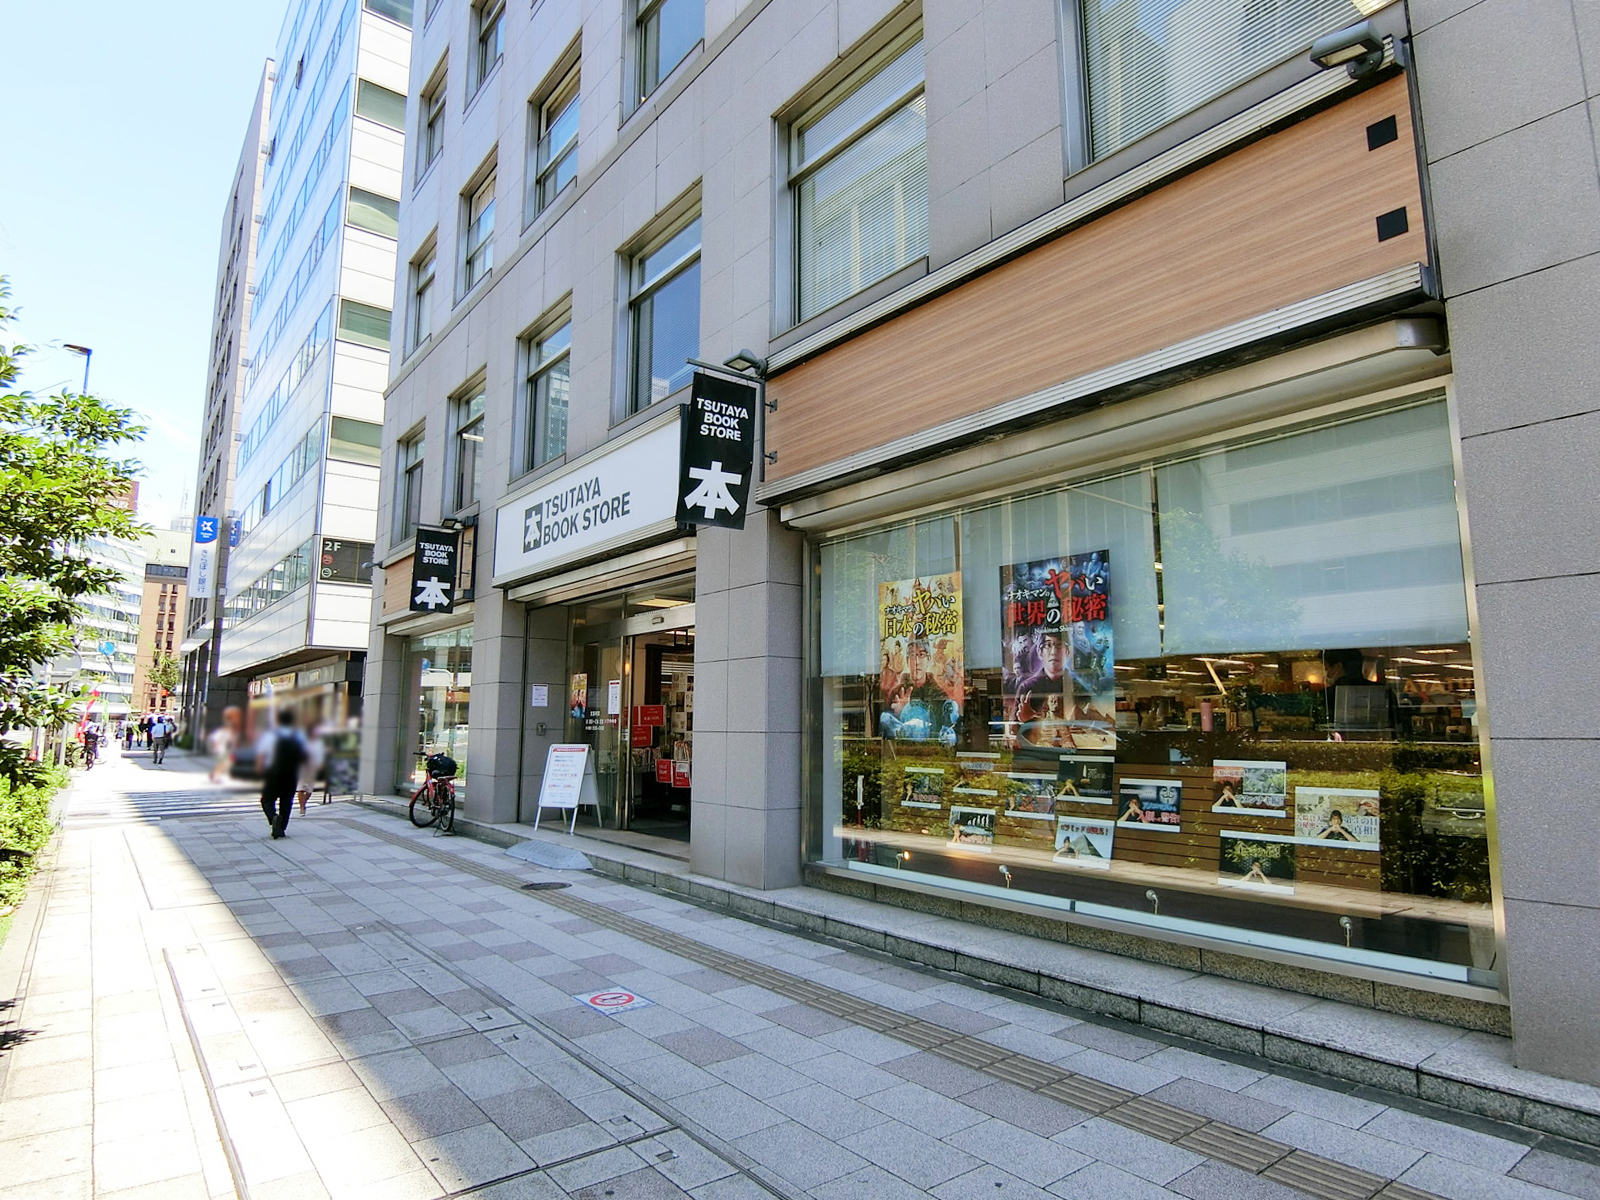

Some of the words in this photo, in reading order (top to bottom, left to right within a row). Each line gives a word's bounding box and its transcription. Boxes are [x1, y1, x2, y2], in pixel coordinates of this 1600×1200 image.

[696, 397, 749, 419] TSUTAYA
[703, 412, 740, 429] BOOK
[699, 425, 742, 442] STORE
[544, 476, 602, 516] TSUTAYA
[683, 461, 743, 519] 本
[543, 515, 579, 547] BOOK
[582, 491, 631, 532] STORE
[324, 541, 342, 552] 2F
[419, 542, 454, 553] TSUTAYA
[424, 550, 448, 559] BOOK
[422, 556, 449, 566] STORE
[414, 576, 451, 609] 本
[1006, 593, 1107, 628] 世界の秘密
[884, 609, 958, 638] 日本の秘密
